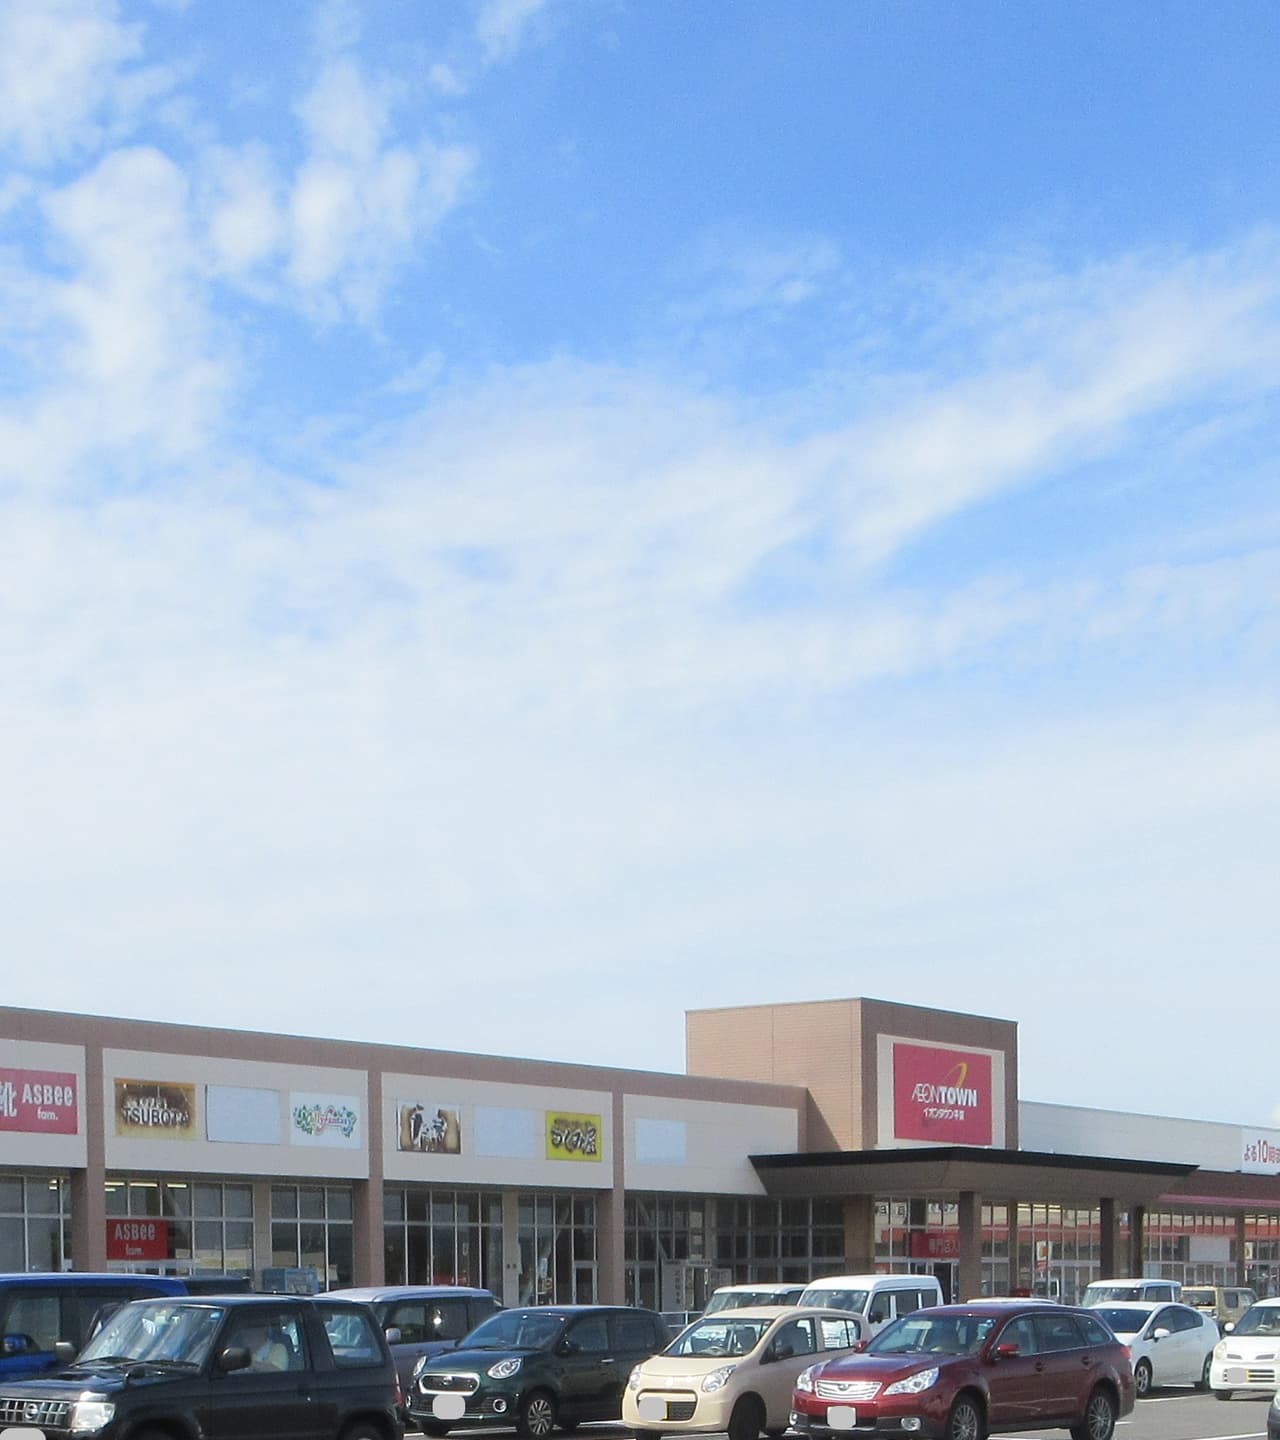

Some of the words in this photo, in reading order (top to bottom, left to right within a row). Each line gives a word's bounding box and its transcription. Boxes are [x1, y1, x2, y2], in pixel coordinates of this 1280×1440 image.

[22, 1084, 73, 1106] ASBee
[37, 1107, 59, 1121] fam.
[115, 1224, 156, 1241] ASBee
